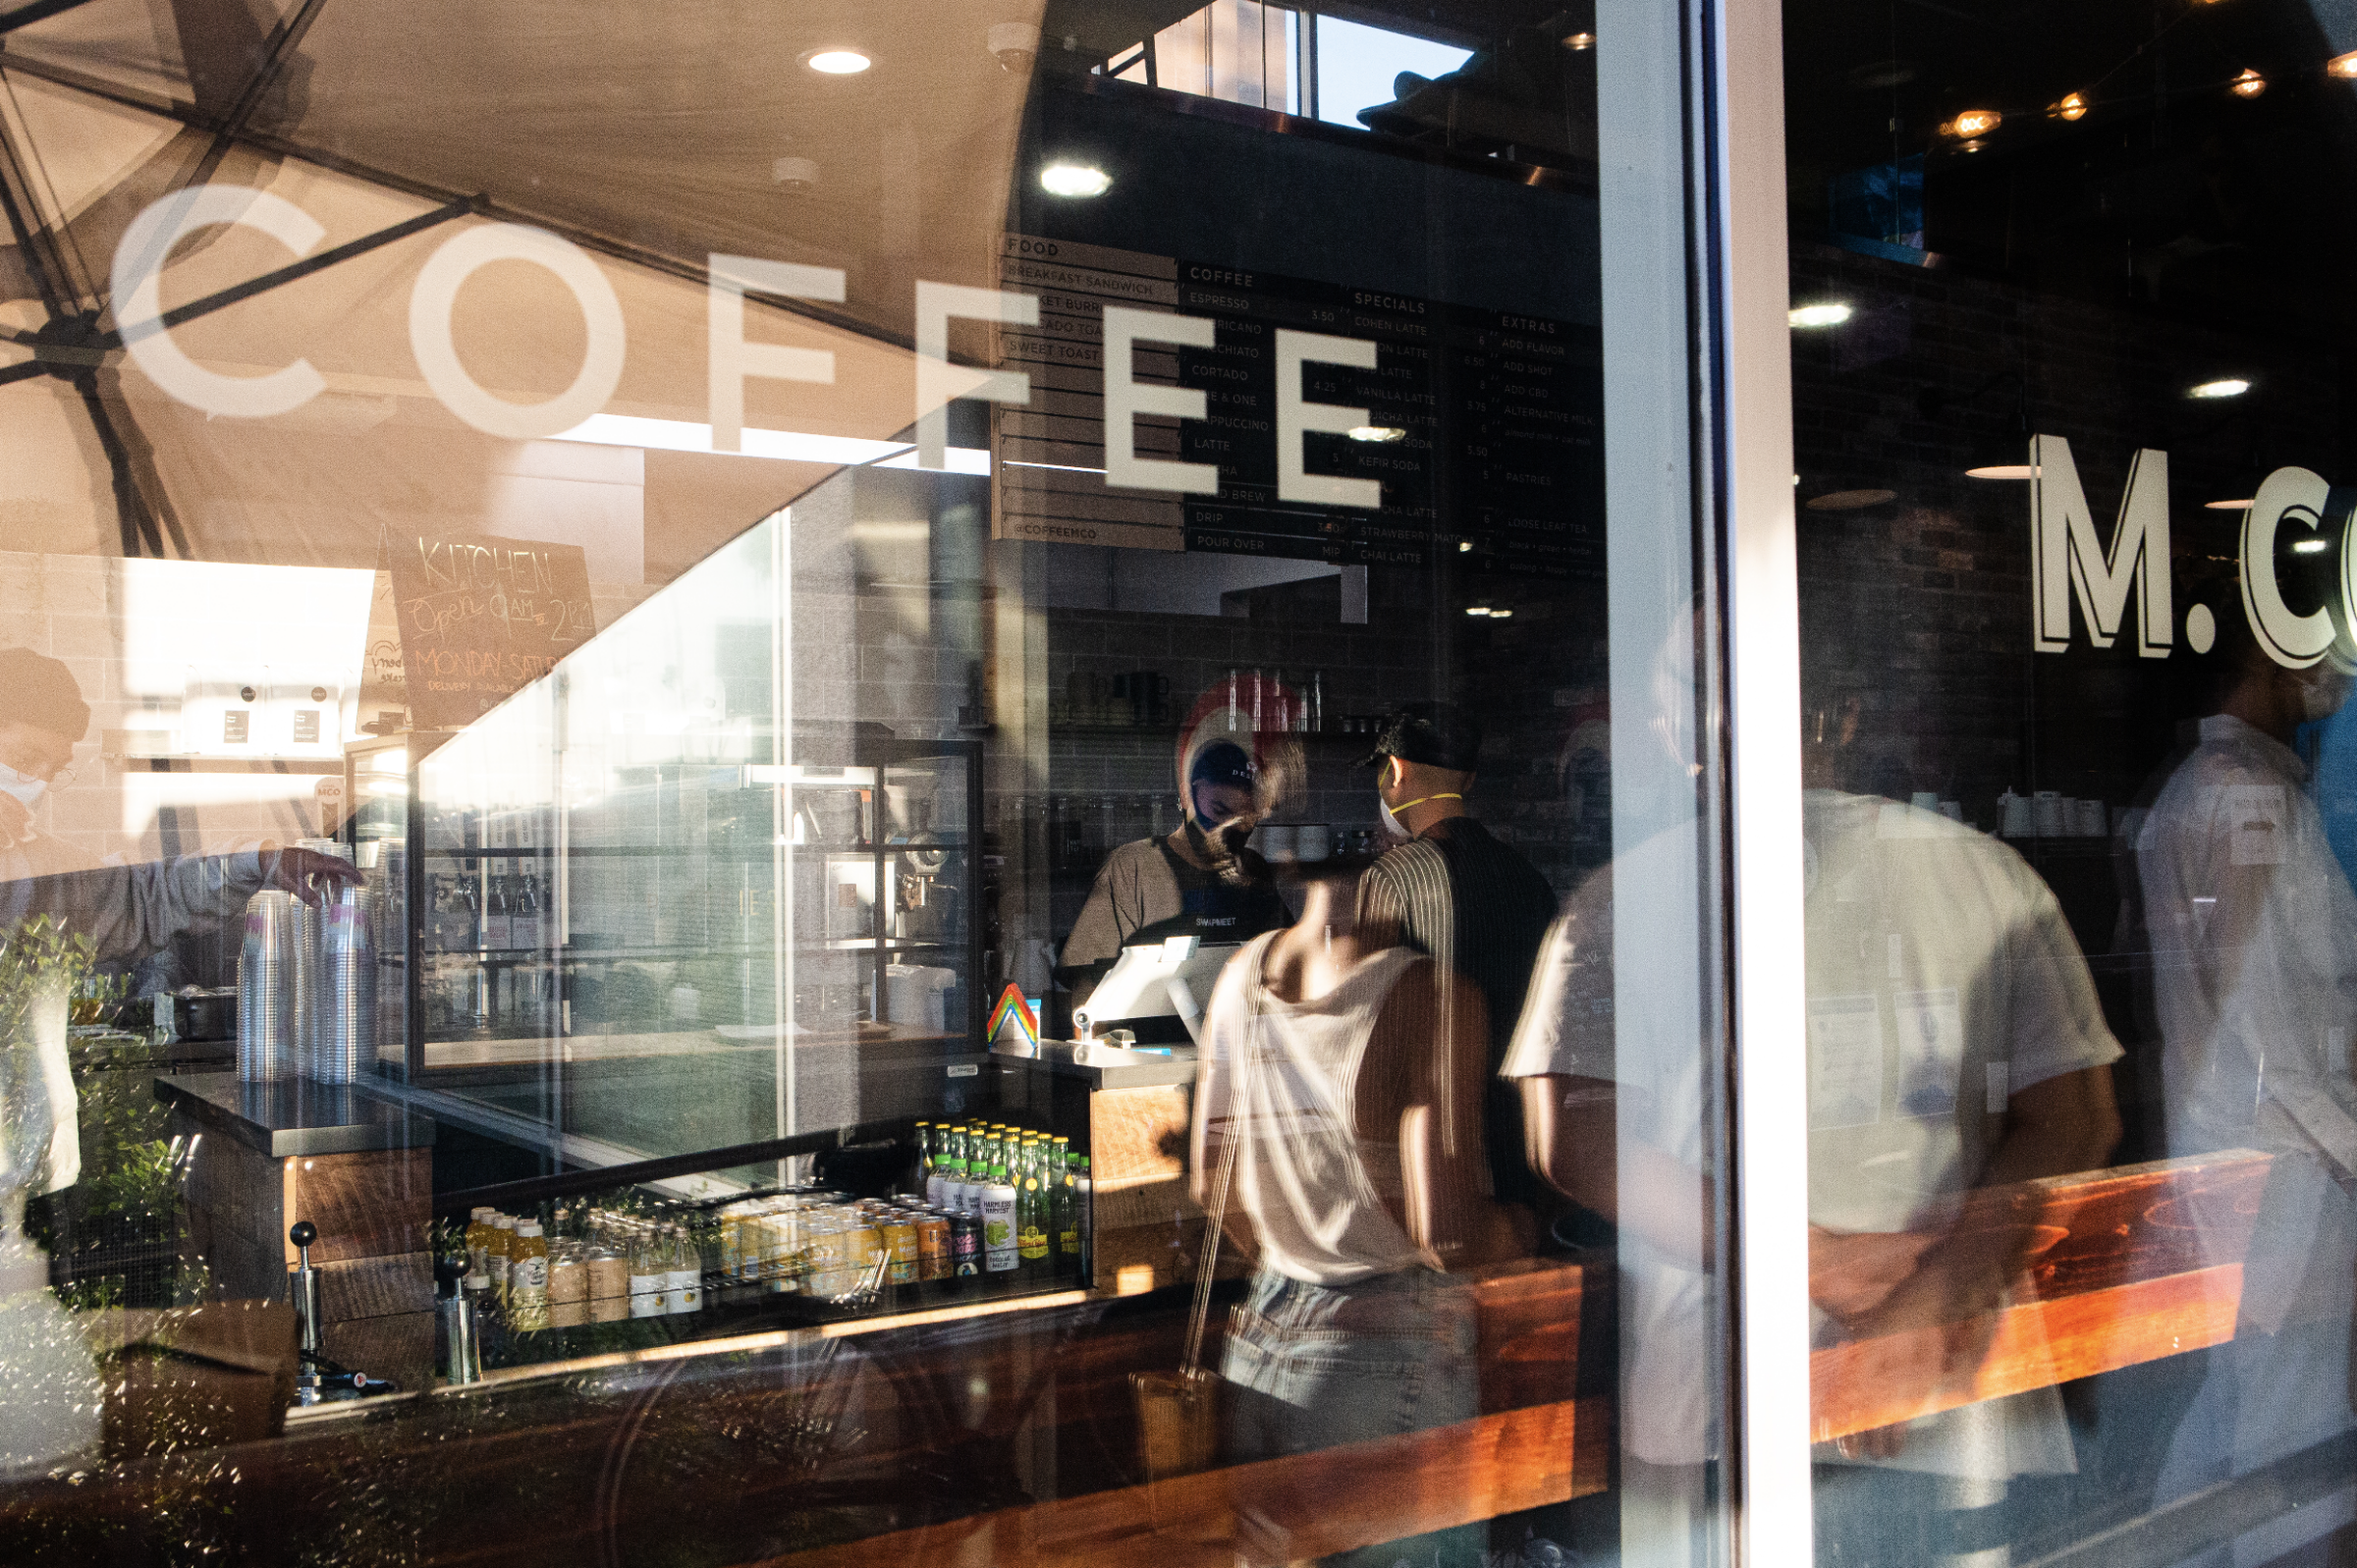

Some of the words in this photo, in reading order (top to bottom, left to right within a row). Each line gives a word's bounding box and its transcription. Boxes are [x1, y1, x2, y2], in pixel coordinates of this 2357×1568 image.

[1008, 238, 1059, 256] FOOD
[1008, 264, 1081, 285] BREAKFAST
[1085, 276, 1153, 295] SANDWICH
[1190, 266, 1253, 288] COFFEE
[1190, 292, 1249, 309] ESPRESSO
[1355, 293, 1425, 314] SPECIALS
[1396, 323, 1427, 336] LATTE
[1502, 315, 1555, 335] EXTRAS
[110, 183, 1381, 509] COFFEE
[1010, 342, 1054, 355] SWEET
[1058, 347, 1099, 361] TOAST
[1397, 345, 1429, 359] LATTE
[1191, 364, 1248, 381] CORTADO
[1380, 367, 1412, 380] LATTE
[1233, 394, 1257, 406] ONE
[1404, 394, 1436, 406] LATTE
[1407, 413, 1438, 427] LATTE
[1194, 438, 1231, 452] LATTE
[1358, 456, 1390, 468] KEFIR
[1392, 460, 1421, 471] SODA
[1232, 489, 1266, 502] BREW
[1196, 512, 1224, 523] DRIP
[1197, 535, 1230, 548] POUR
[1233, 538, 1265, 551] OVER
[1360, 549, 1387, 561] CHAI
[1390, 551, 1422, 564] LATTE
[417, 536, 553, 596] KITCHEN
